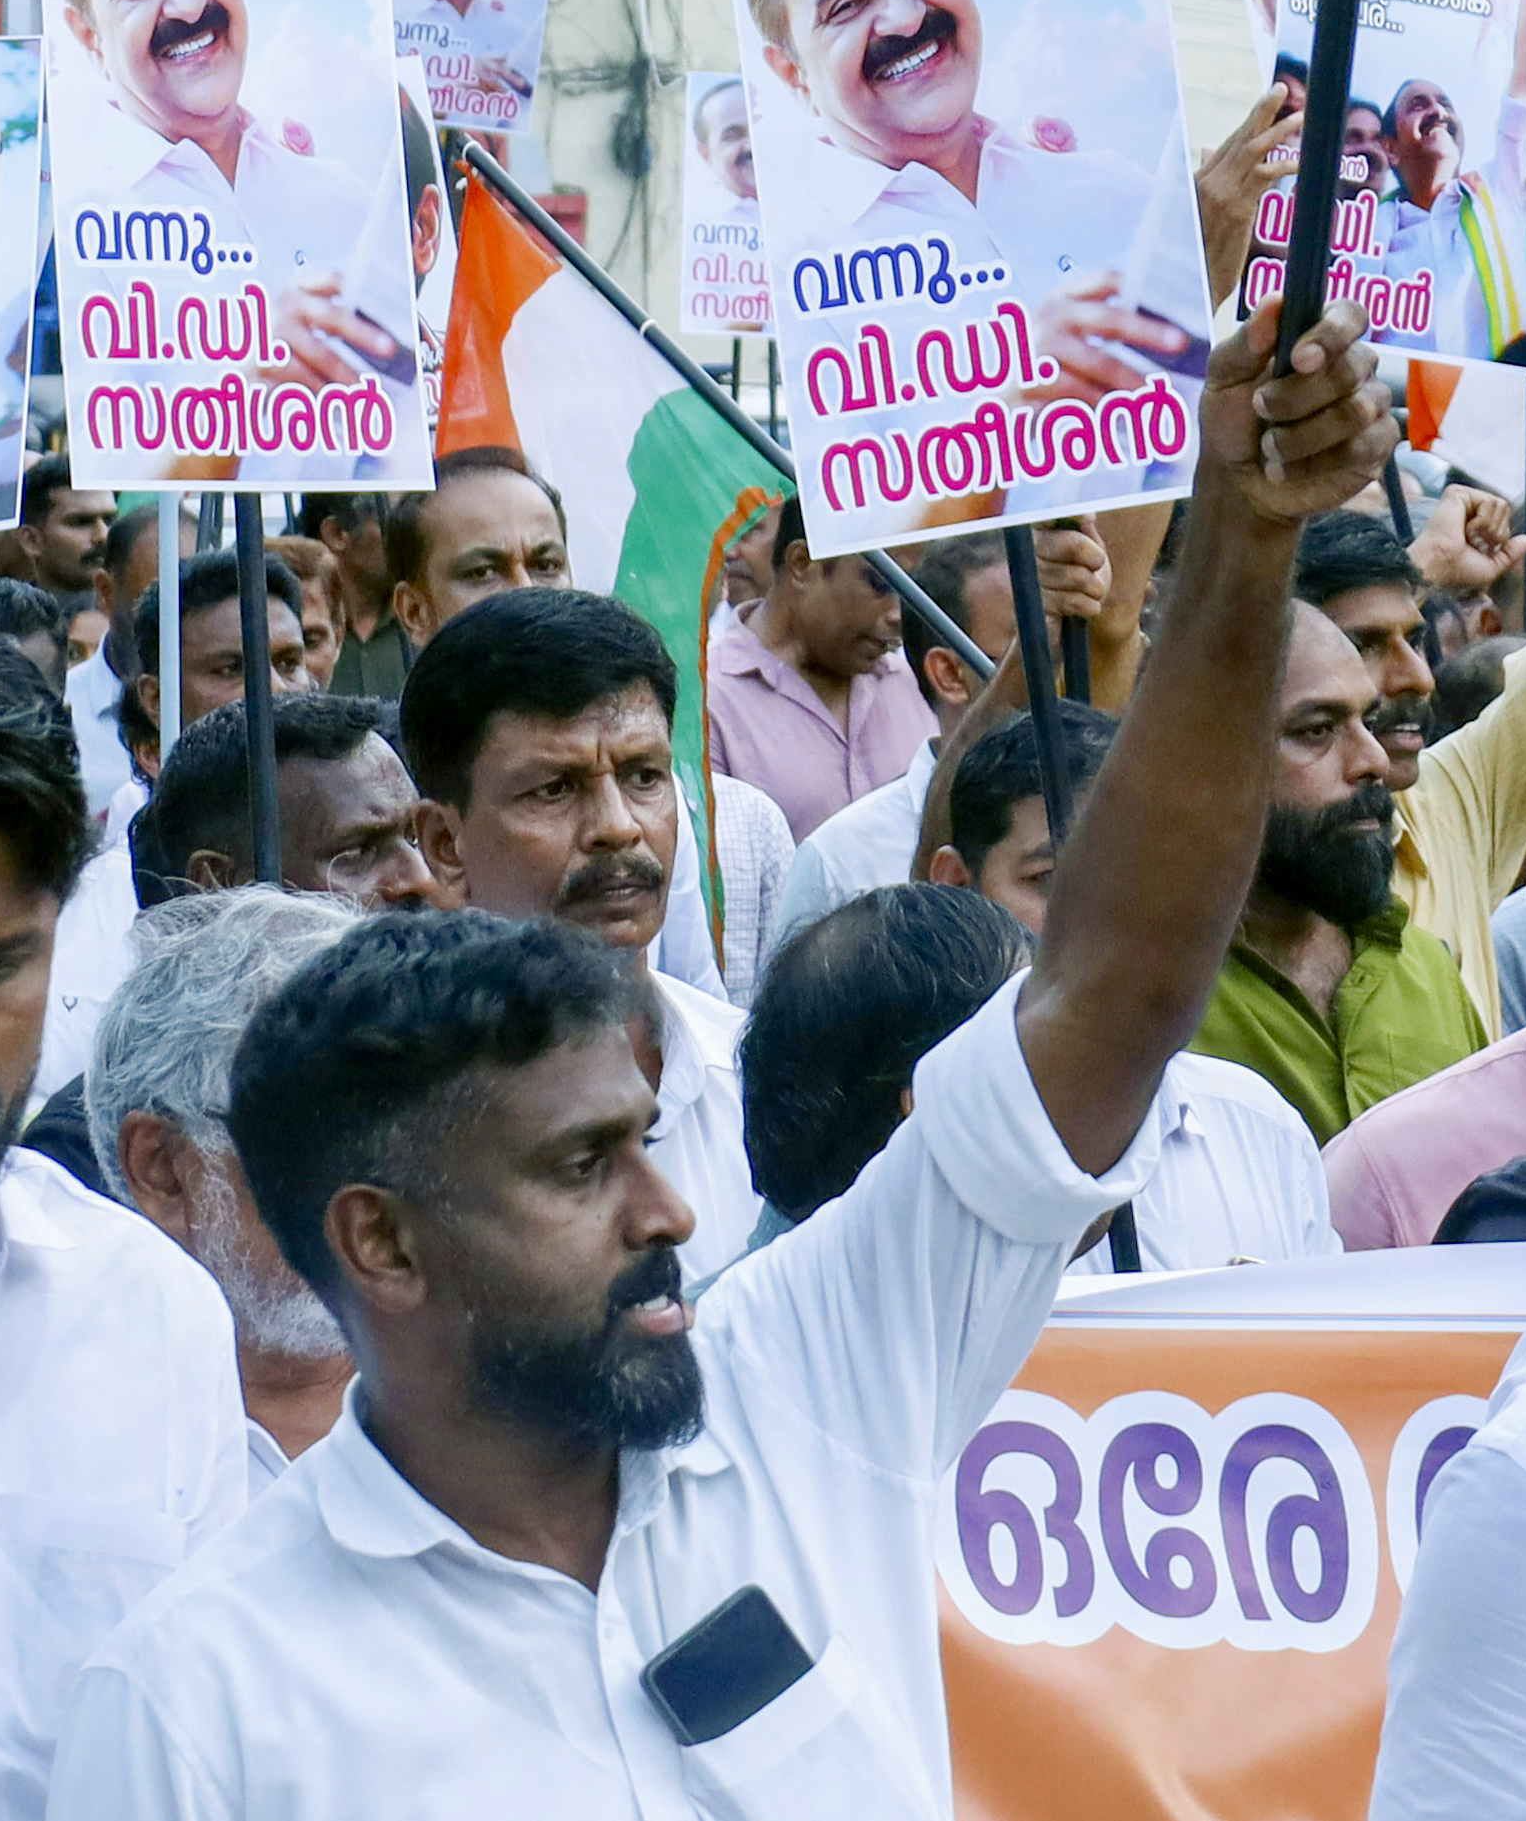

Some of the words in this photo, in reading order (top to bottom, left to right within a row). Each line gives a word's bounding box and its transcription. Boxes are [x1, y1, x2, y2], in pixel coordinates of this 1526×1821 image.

[76, 209, 254, 275] വന്നു...
[793, 236, 1007, 313] വന്നു...
[83, 284, 287, 362] വി.ഡി.
[807, 305, 1056, 417] വി.ഡി.
[88, 376, 394, 452] സതീശൻ
[823, 381, 1187, 512] സതീശൻ
[956, 1419, 1351, 1627] ഒരേ
